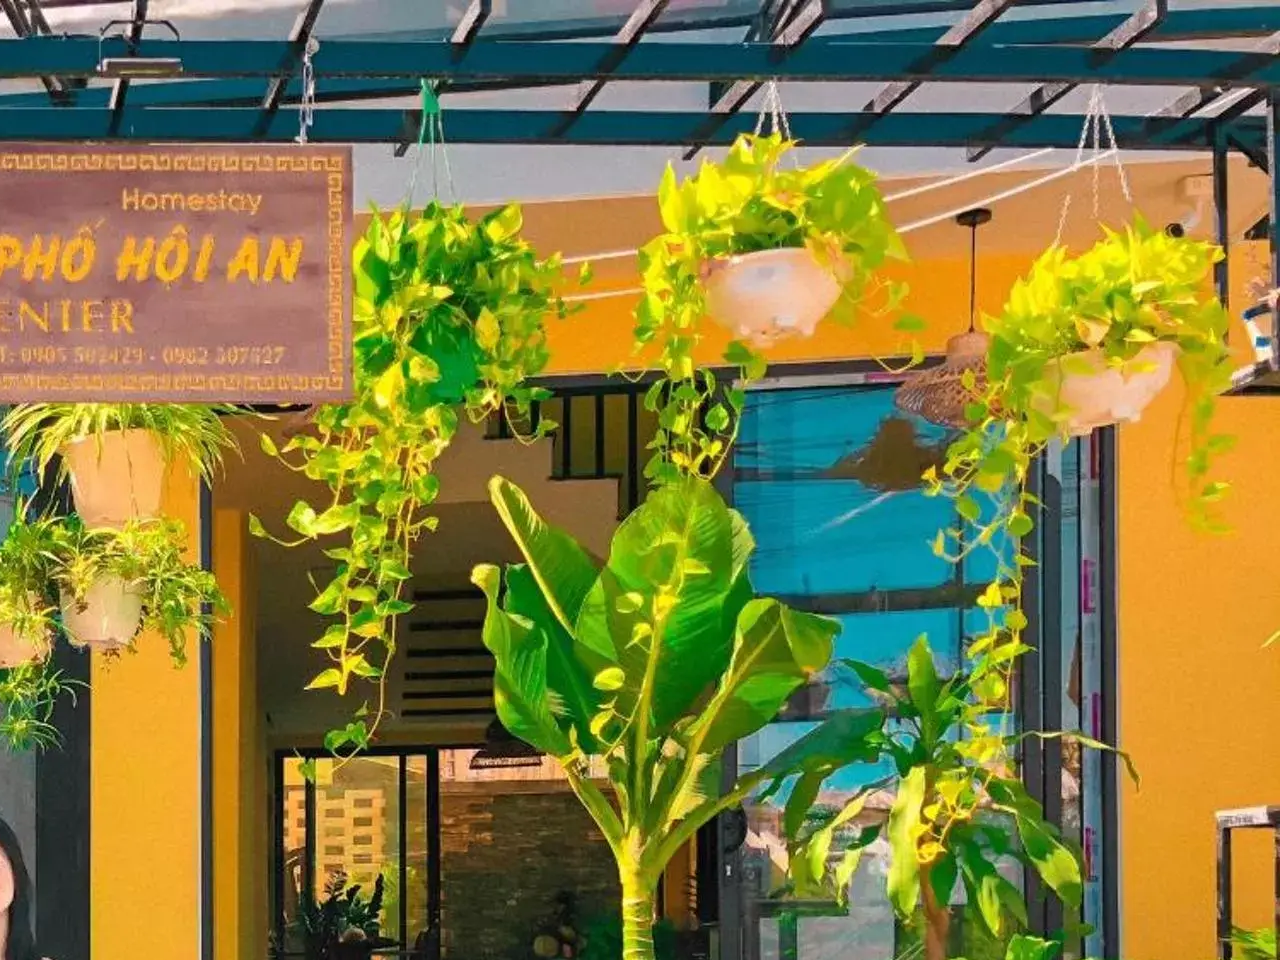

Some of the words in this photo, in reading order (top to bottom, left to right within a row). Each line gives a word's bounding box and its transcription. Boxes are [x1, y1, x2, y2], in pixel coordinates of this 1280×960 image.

[121, 187, 263, 216] Homestay
[116, 223, 216, 290] HỘI
[227, 234, 304, 286] AN
